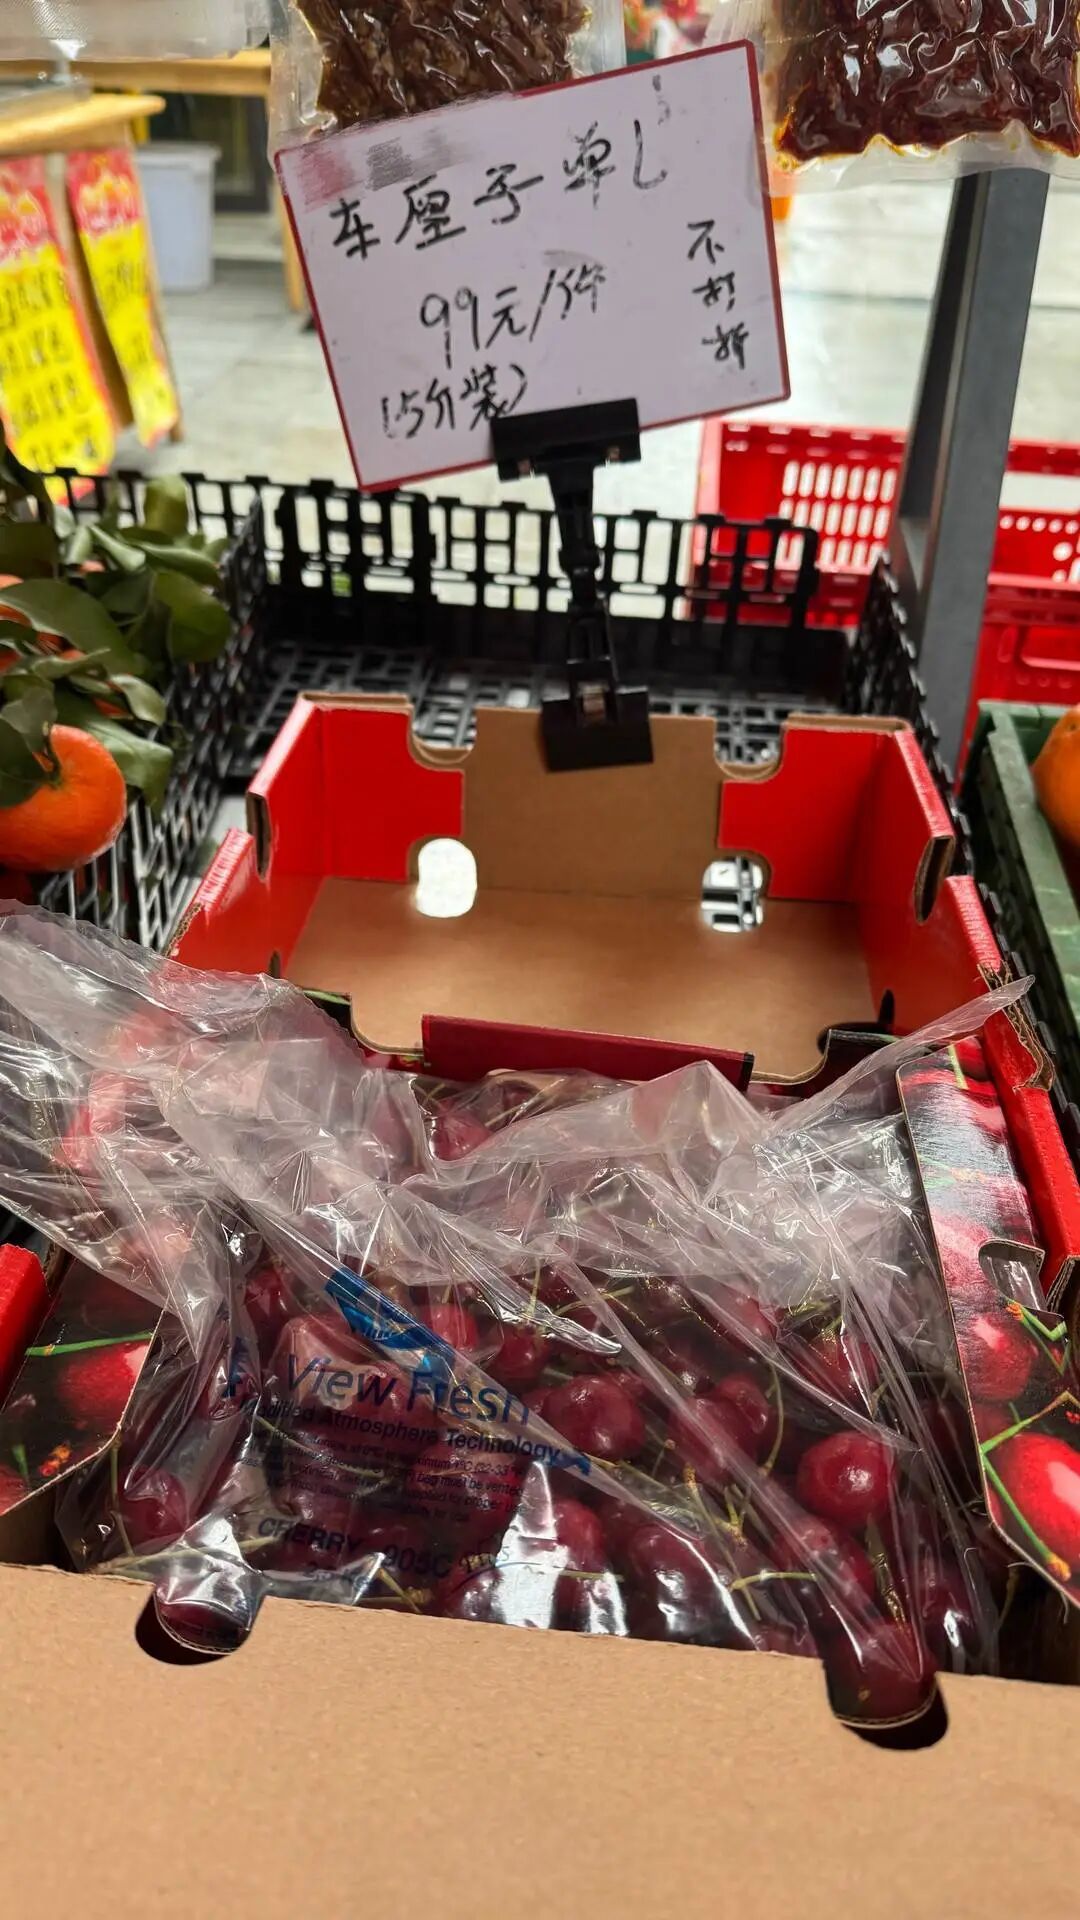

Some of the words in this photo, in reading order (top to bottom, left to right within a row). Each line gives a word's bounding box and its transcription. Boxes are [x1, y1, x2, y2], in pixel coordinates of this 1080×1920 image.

[687, 219, 749, 370] 不打折
[288, 1353, 397, 1407] View
[407, 1370, 530, 1426] Fresh
[319, 1405, 438, 1442] Atmosphere
[447, 1427, 563, 1464] Technology
[258, 1516, 364, 1554] CHERRY
